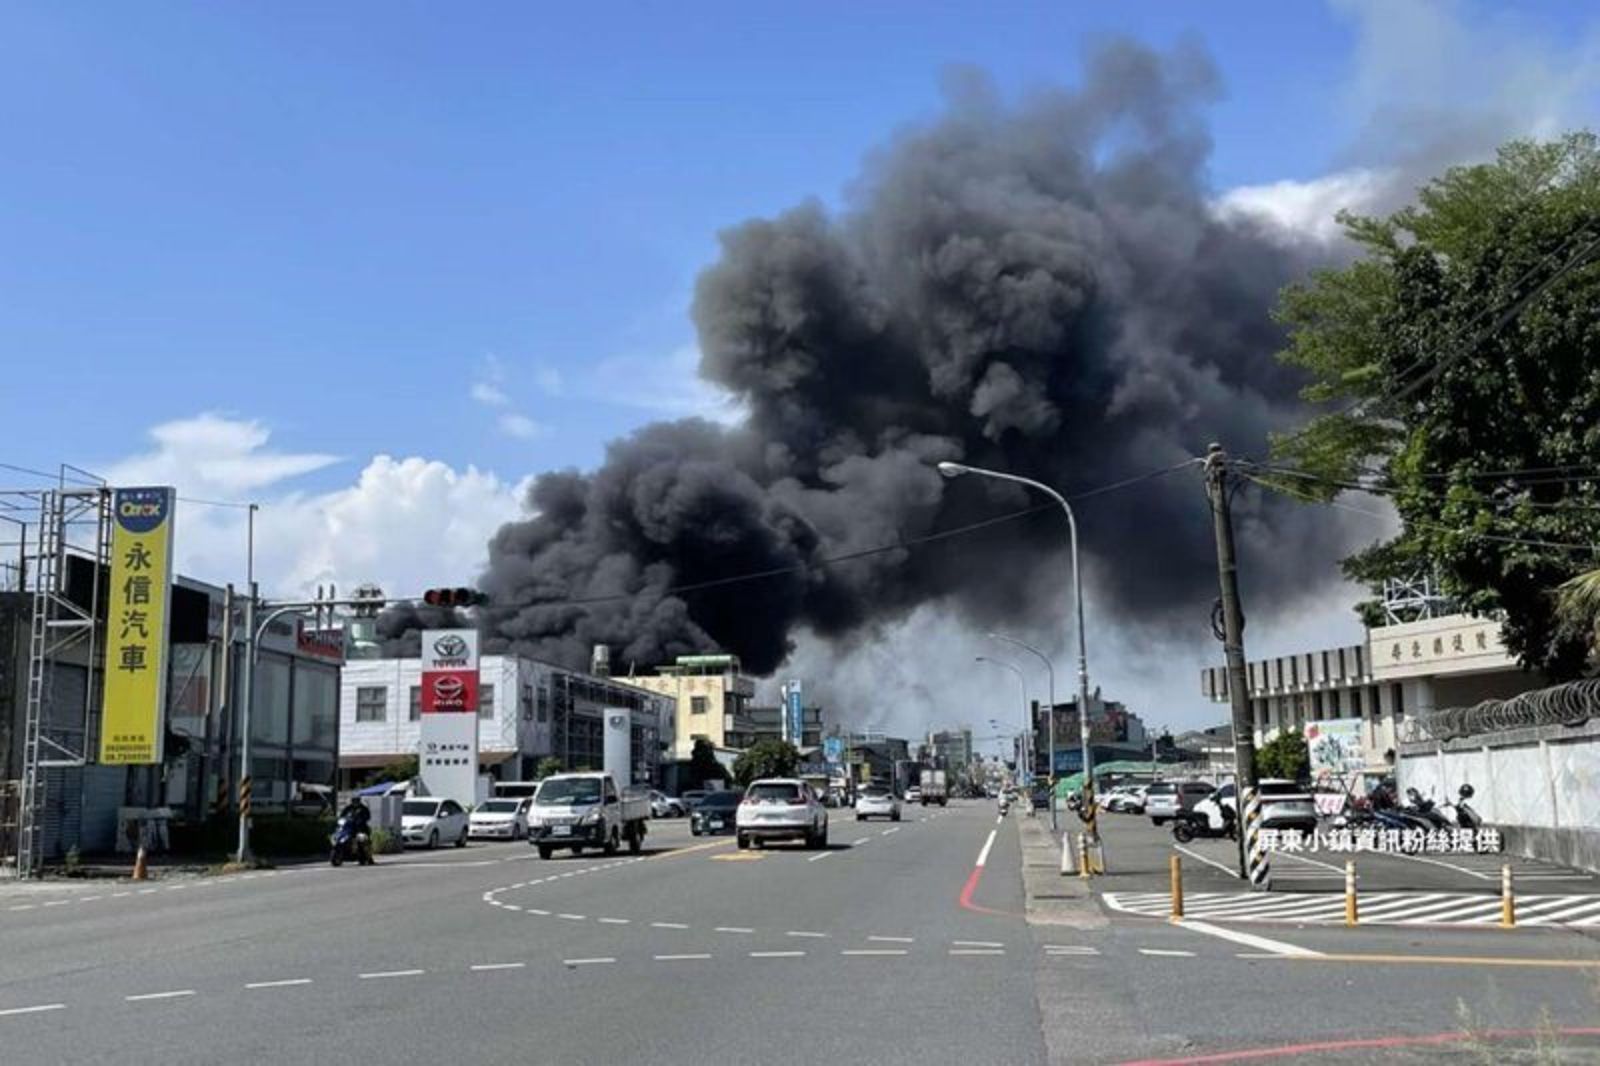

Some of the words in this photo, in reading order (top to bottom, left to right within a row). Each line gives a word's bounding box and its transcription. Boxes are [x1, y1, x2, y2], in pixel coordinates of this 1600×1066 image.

[118, 542, 152, 673] 永信汽車
[432, 659, 467, 668] TOYOTA
